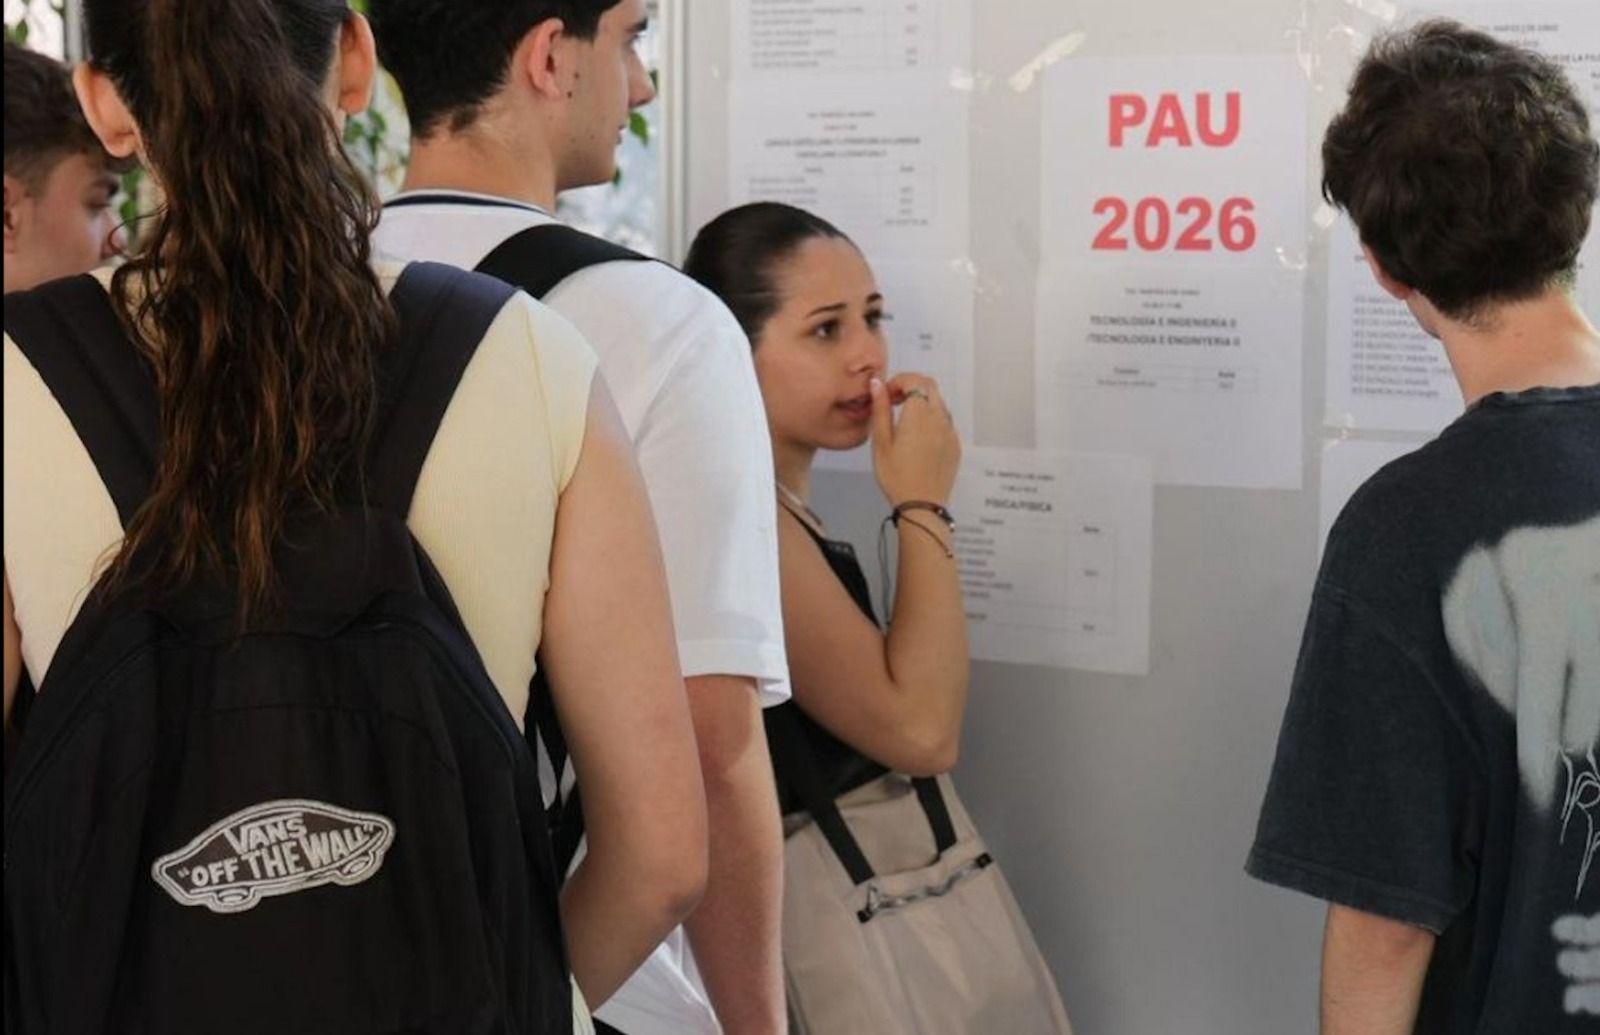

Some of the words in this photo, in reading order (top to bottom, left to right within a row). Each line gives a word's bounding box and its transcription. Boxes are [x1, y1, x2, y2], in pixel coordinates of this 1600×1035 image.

[1109, 92, 1241, 148] PAU
[1091, 196, 1257, 252] 2026
[222, 811, 308, 856] VANS
[241, 841, 305, 880] THE
